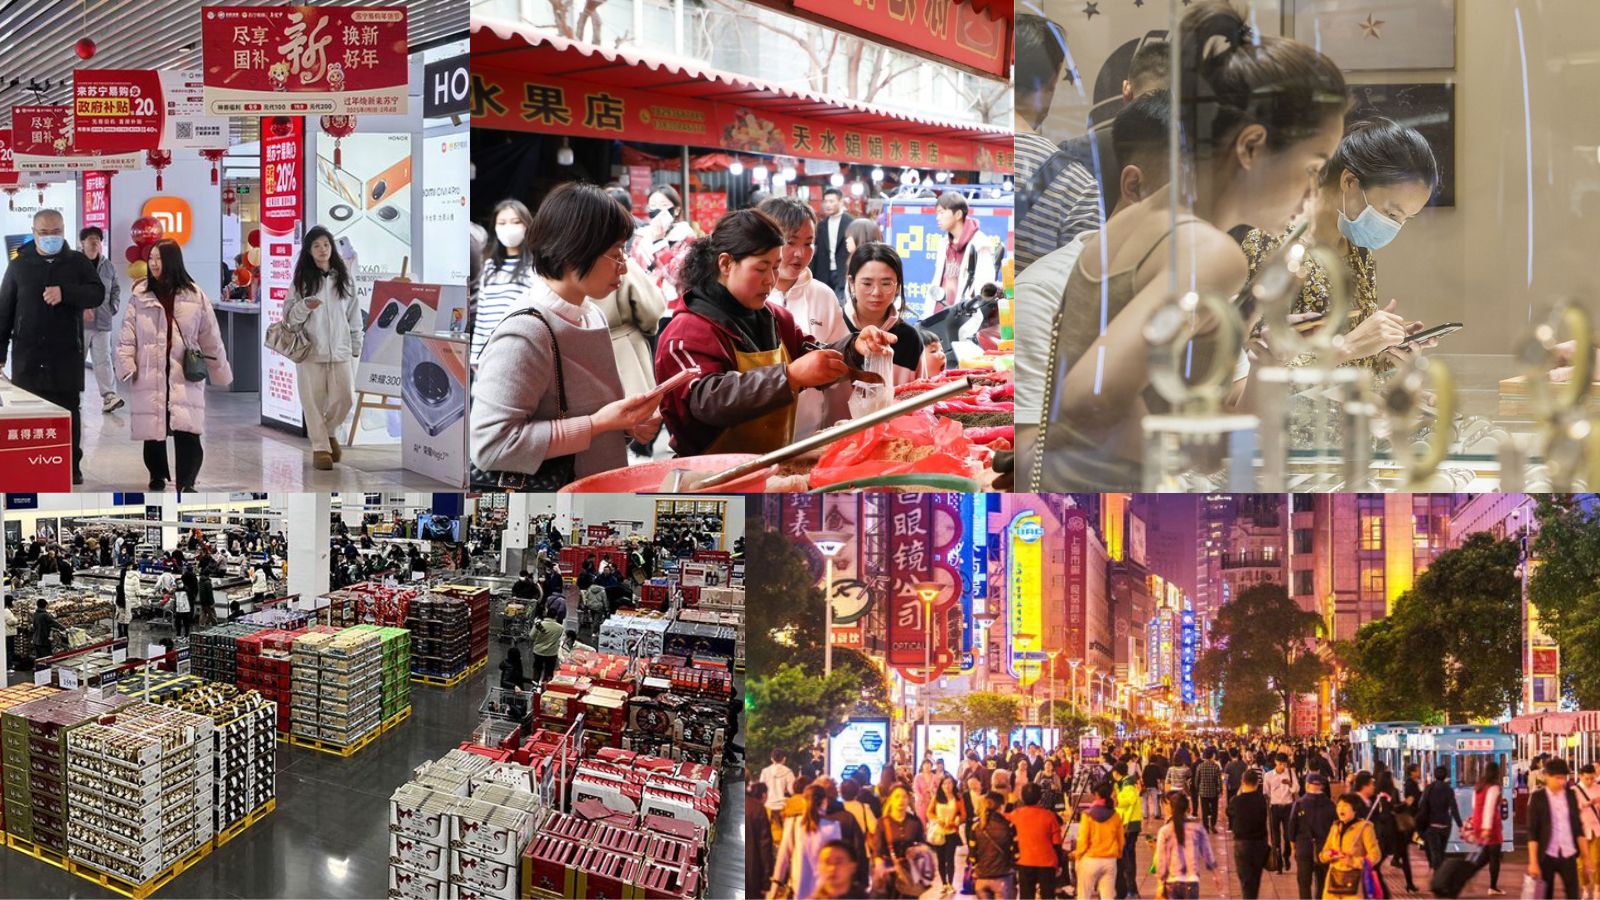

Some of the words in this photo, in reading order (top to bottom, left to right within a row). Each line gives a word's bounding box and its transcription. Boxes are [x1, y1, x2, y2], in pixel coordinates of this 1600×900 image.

[232, 26, 269, 46] 尽享
[342, 25, 379, 45] 换新
[278, 12, 333, 84] 新
[233, 50, 270, 70] 国补
[343, 48, 379, 69] 好年
[77, 86, 129, 97] 来苏宁易购
[78, 100, 129, 113] 政府补贴
[470, 73, 625, 132] 水果店
[792, 124, 939, 164] 天水娟娟水果店
[276, 162, 297, 192] 20%
[8, 427, 57, 440] 赢得漂亮
[28, 454, 63, 465] vivo
